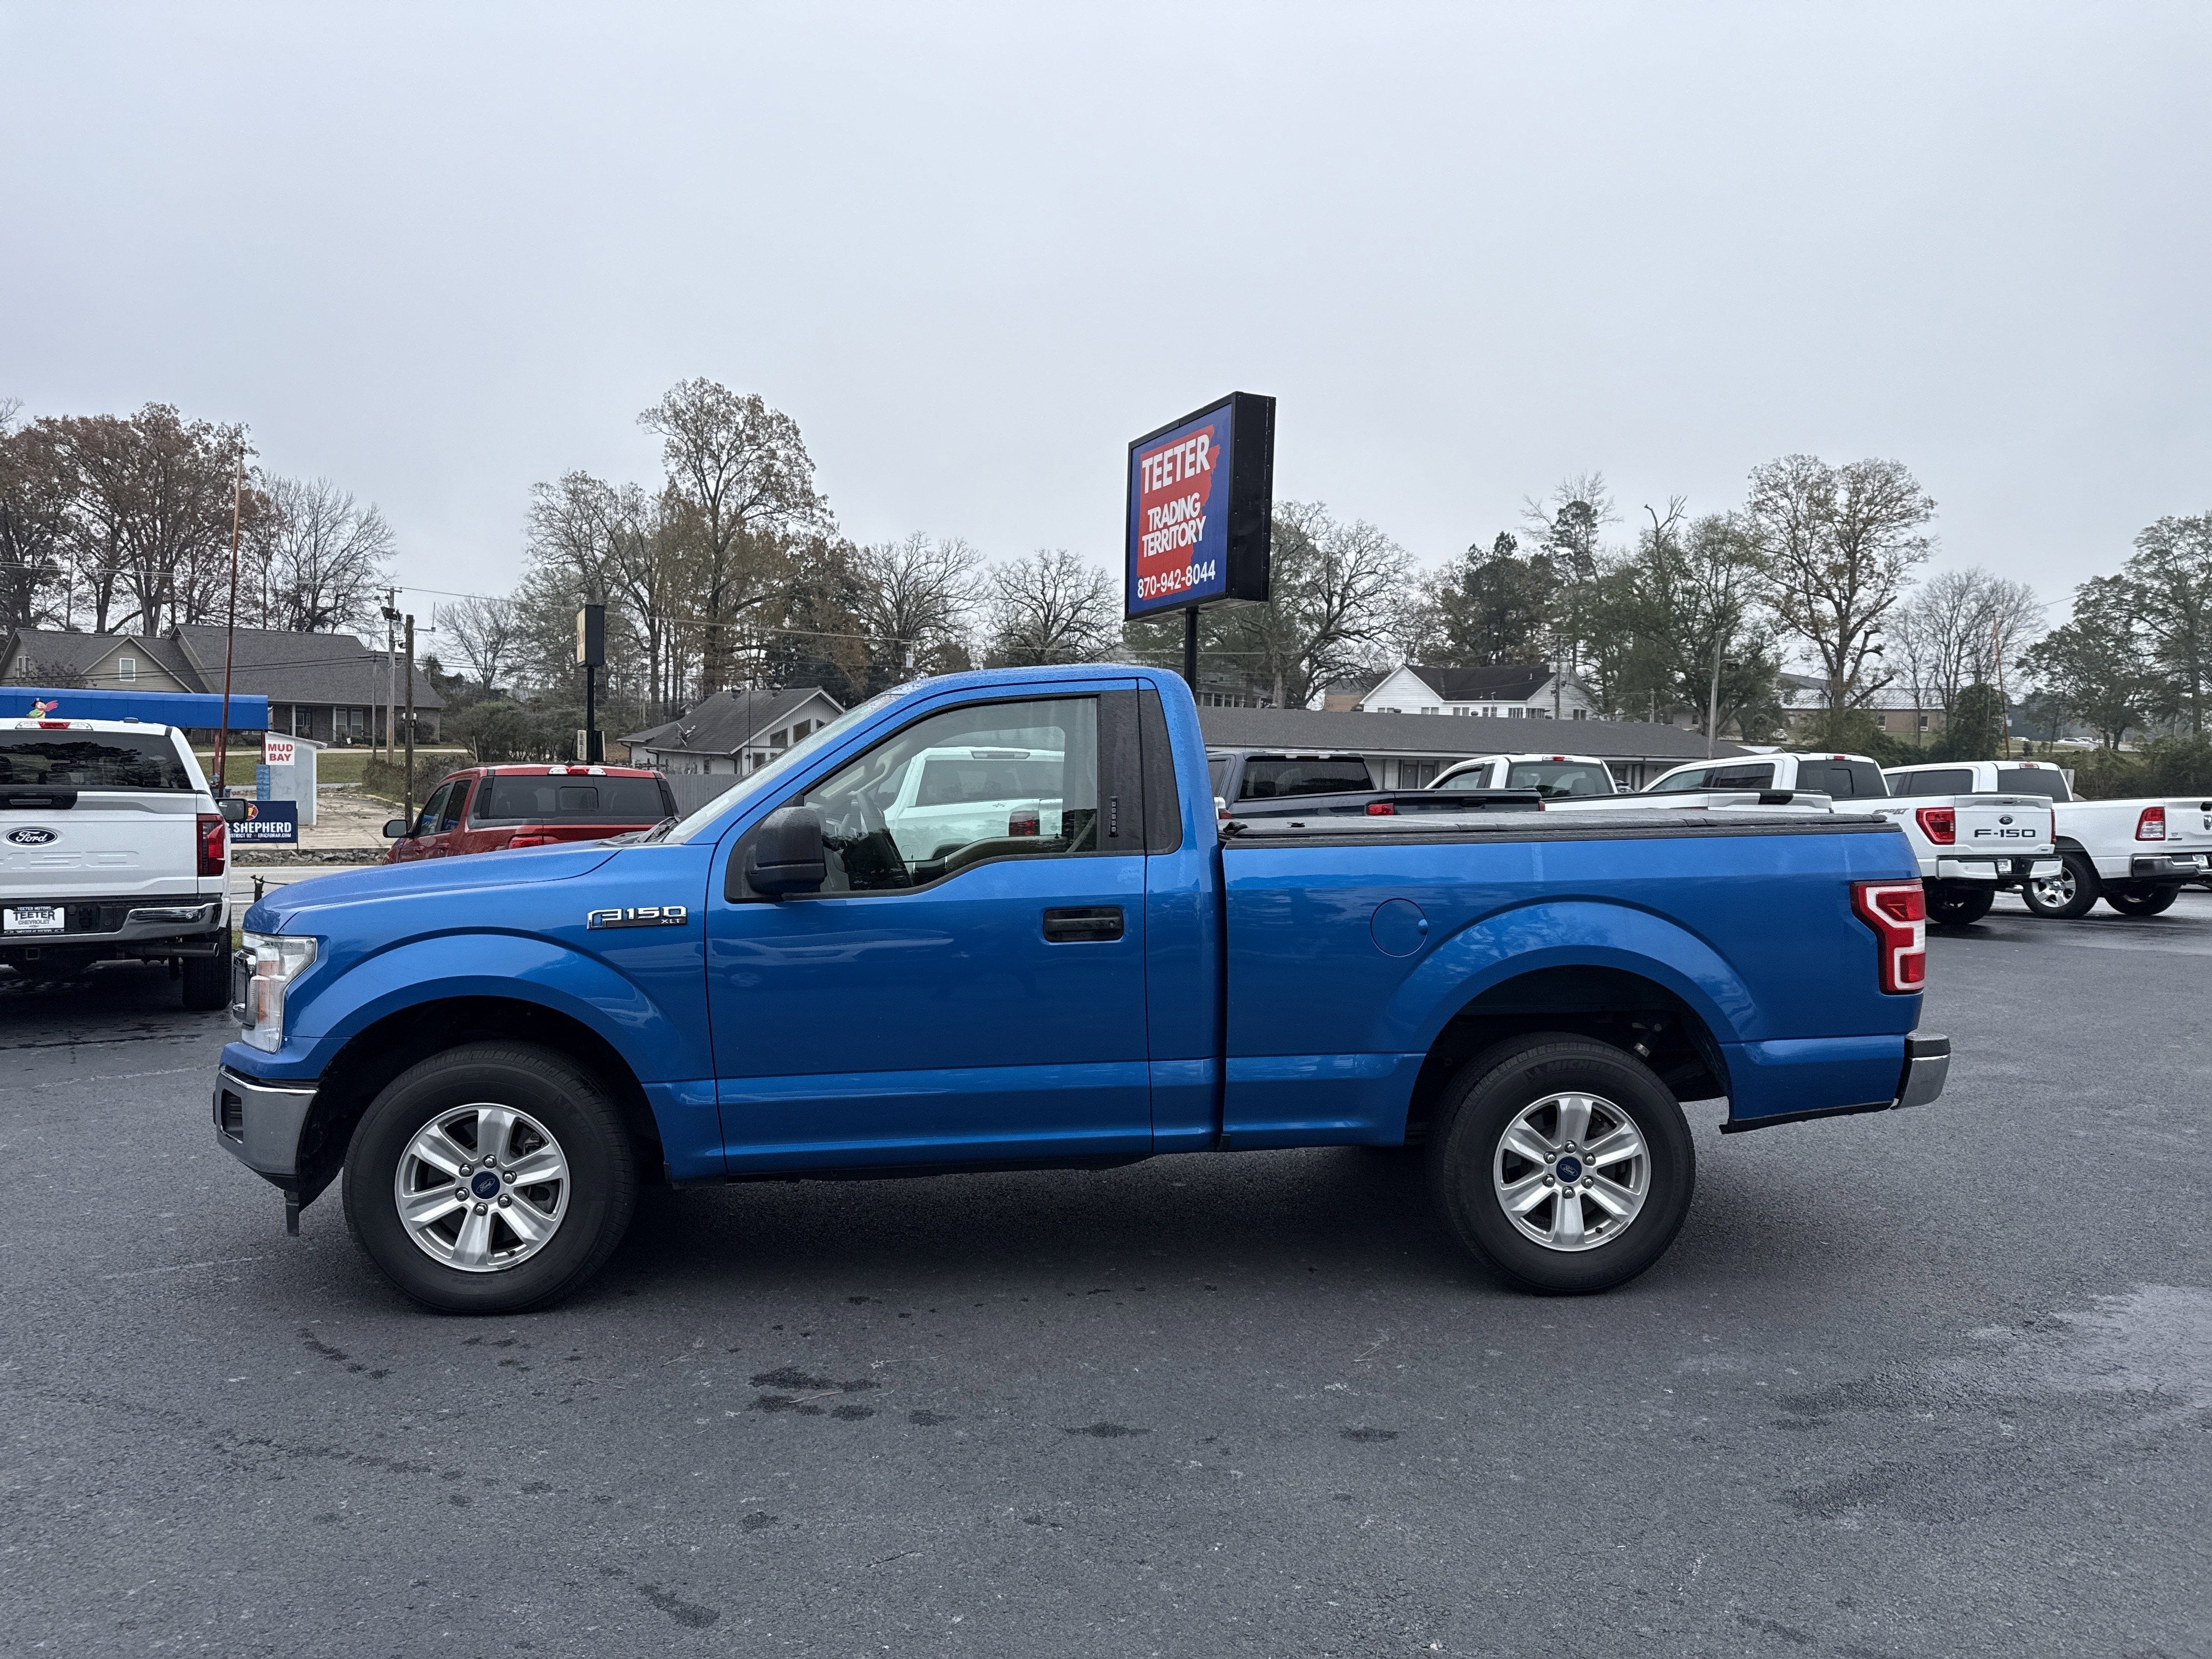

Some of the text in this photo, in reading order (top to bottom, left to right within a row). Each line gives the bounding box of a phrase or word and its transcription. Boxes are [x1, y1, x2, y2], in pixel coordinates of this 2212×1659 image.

[1142, 434, 1210, 494] TEETER
[1148, 492, 1200, 532] TRADING
[1142, 516, 1206, 557] TERRITORY
[1137, 560, 1216, 599] 870-942-8044
[268, 743, 294, 752] MUD
[269, 753, 291, 761] BAY
[233, 822, 292, 833] SHEPHERD
[15, 831, 48, 842] Ford
[1974, 829, 2036, 838] F-150
[13, 911, 55, 921] TEETER
